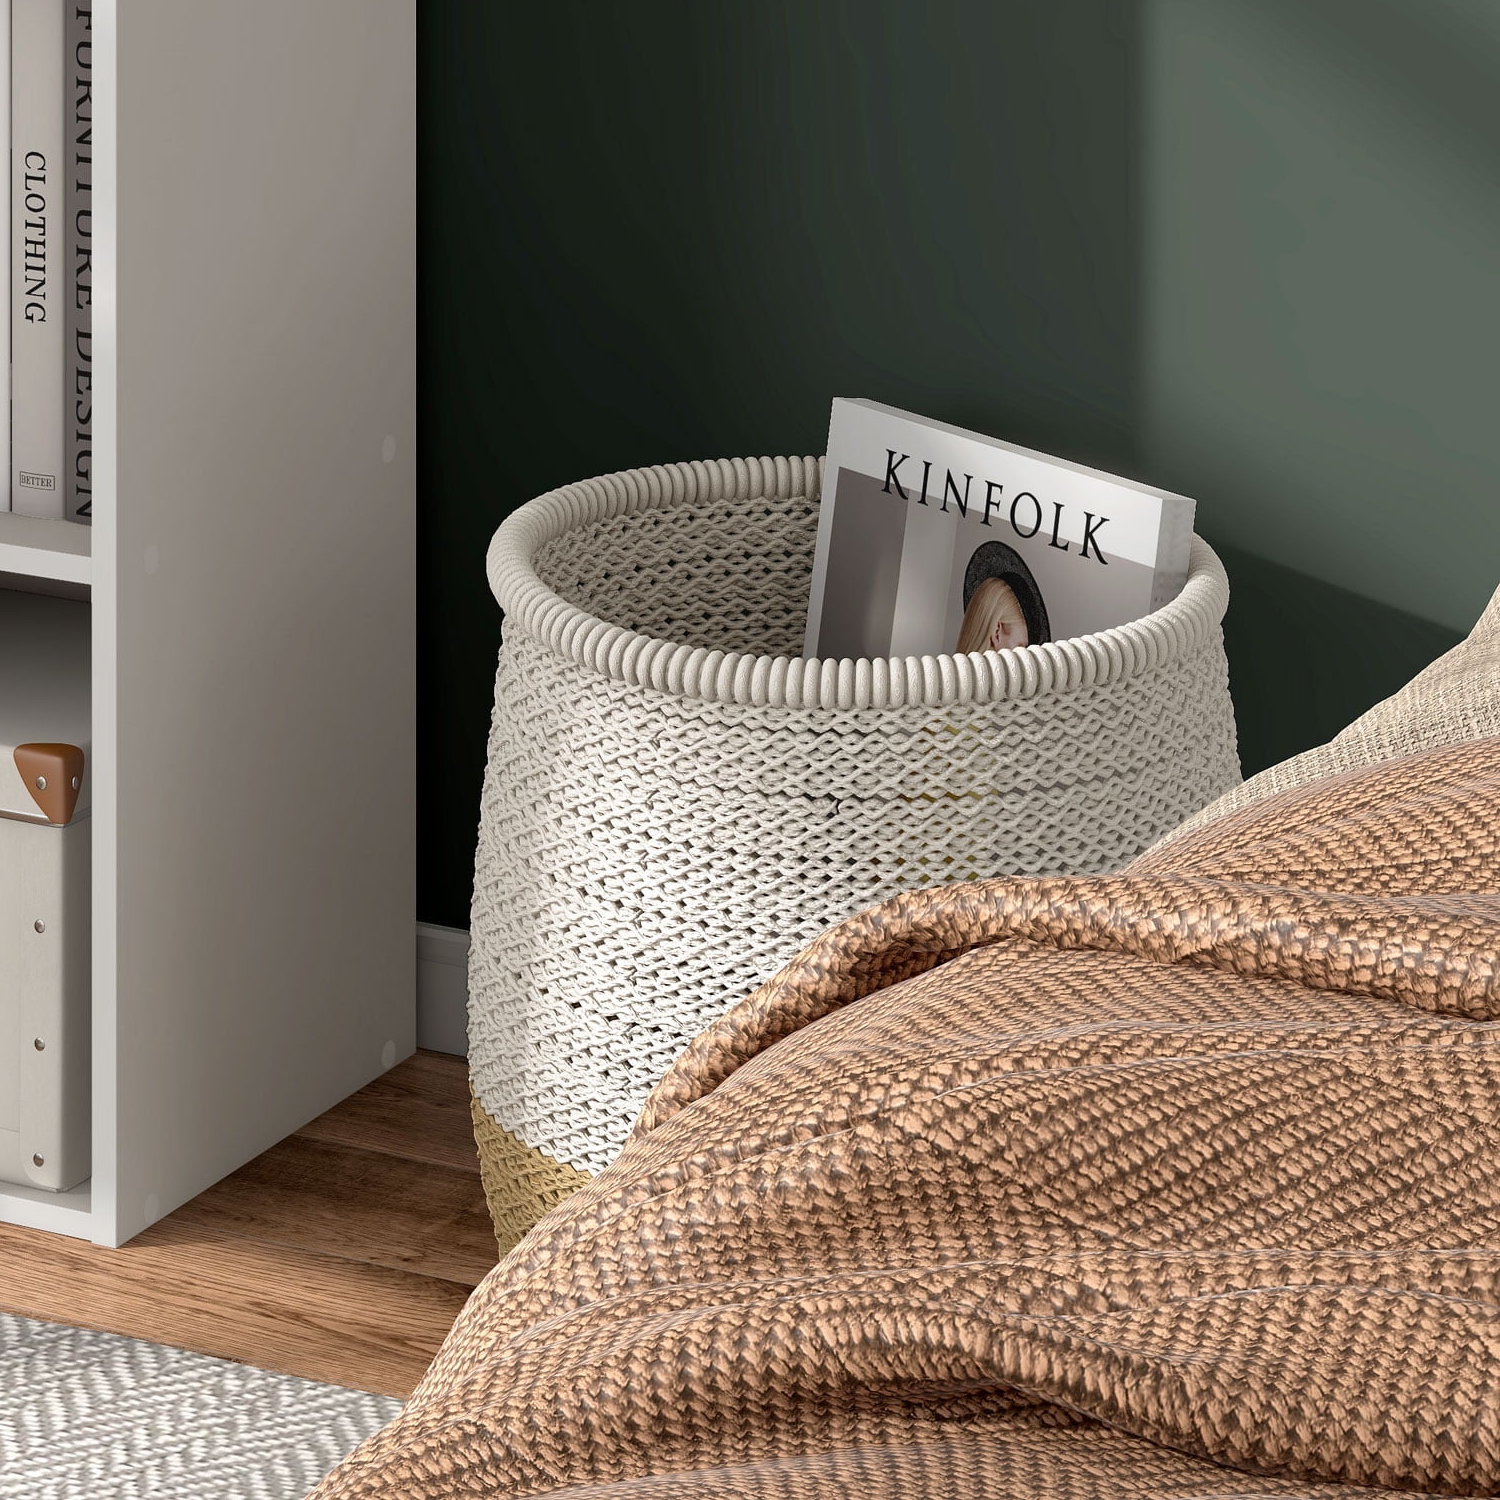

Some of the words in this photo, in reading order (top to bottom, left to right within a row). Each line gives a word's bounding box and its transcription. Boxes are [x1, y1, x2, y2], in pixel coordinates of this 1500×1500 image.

[24, 150, 46, 324] CLOTHING
[21, 474, 52, 488] BETTER
[881, 448, 1110, 565] KINFOLK
